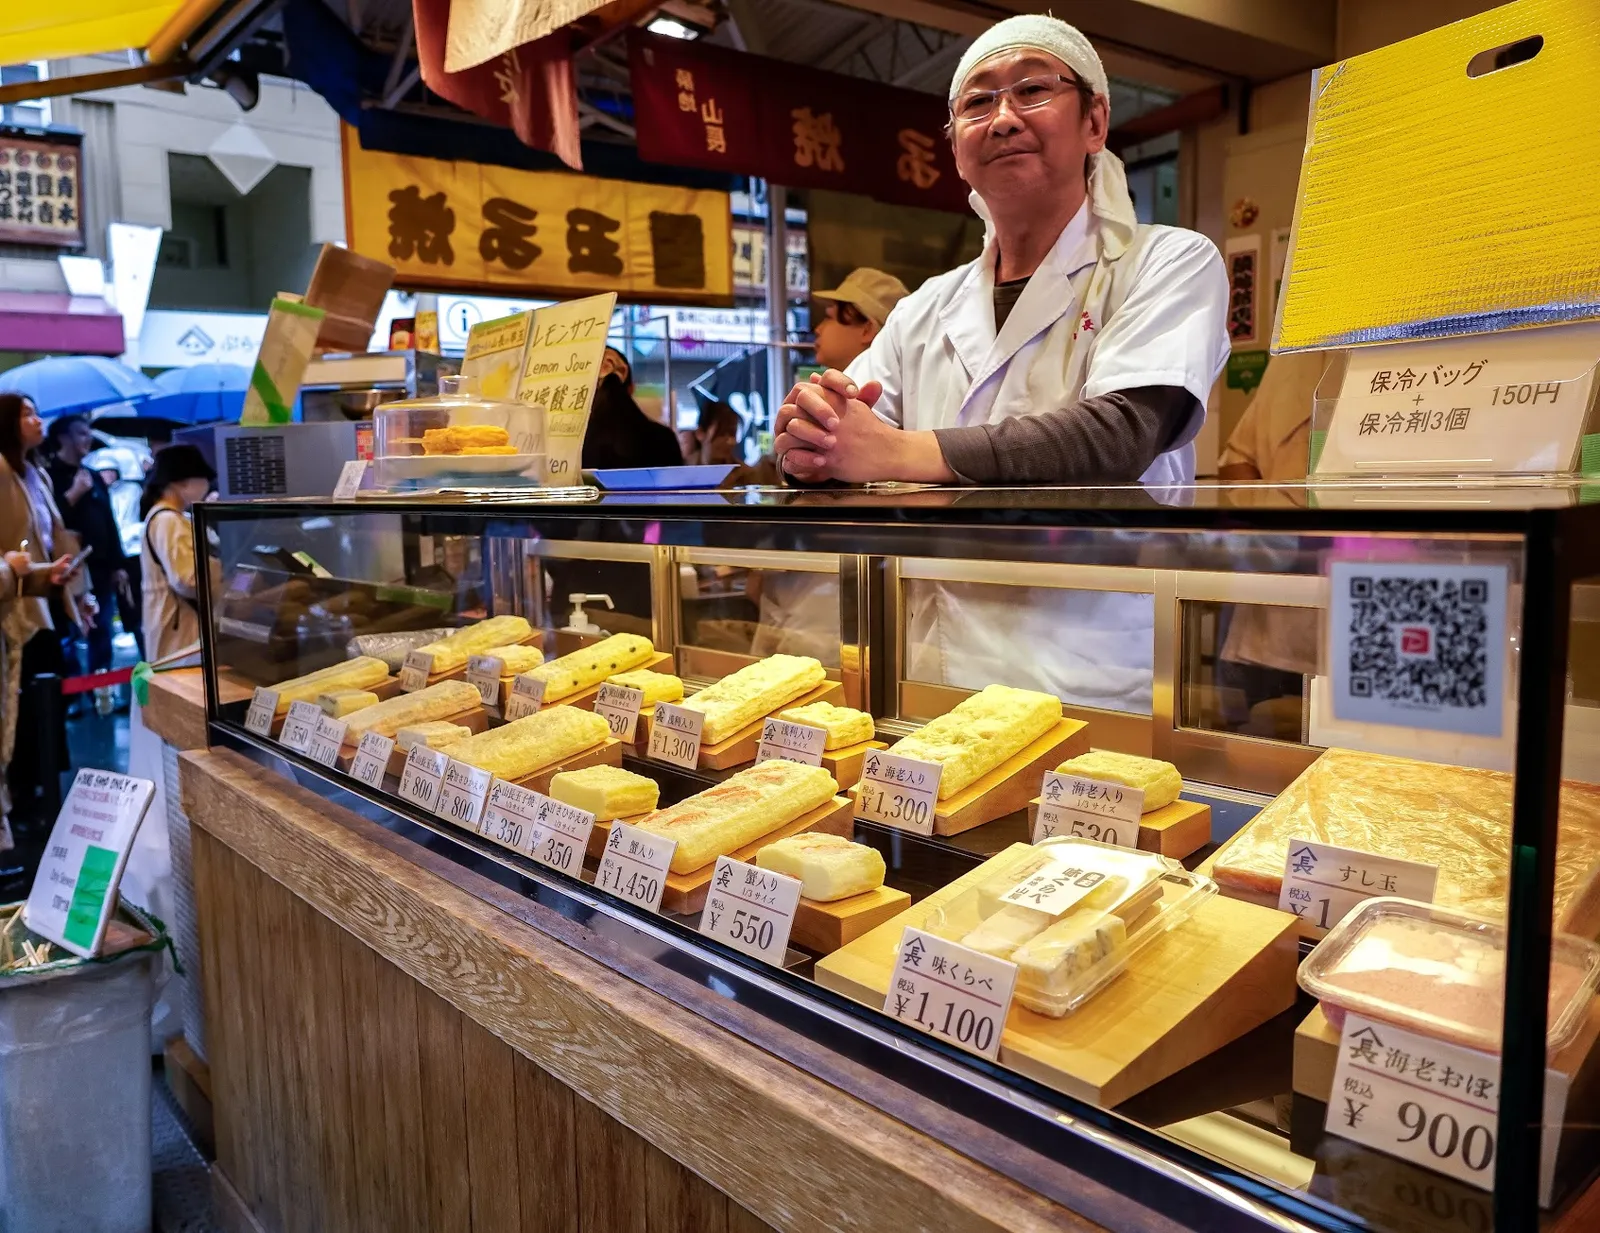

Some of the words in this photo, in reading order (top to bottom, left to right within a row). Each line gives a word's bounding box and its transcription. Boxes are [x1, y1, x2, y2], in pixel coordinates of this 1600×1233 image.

[532, 317, 605, 348] レモンサワー
[524, 358, 559, 378] Lemon
[566, 353, 592, 374] Sour
[1370, 359, 1488, 393] 保冷バッグ
[1491, 383, 1560, 406] 150円
[1358, 407, 1470, 436] 保冷剤3個
[291, 725, 309, 745] 550
[608, 713, 629, 735] 530
[781, 724, 814, 740] 浅利入り
[653, 735, 695, 761] ¥1,300
[361, 760, 379, 783] 450
[884, 765, 925, 785] 海老入り
[412, 775, 433, 802] 800
[862, 785, 874, 795] 税込
[1072, 781, 1123, 803] 海老入り
[451, 795, 474, 823] 800
[861, 791, 927, 824] ¥1,300
[1093, 803, 1116, 814] サイズ
[496, 817, 523, 848] 350
[1071, 820, 1118, 845] 530
[544, 838, 573, 870] 350
[629, 840, 654, 860] 蟹入り
[602, 866, 657, 904] ¥1,450
[745, 868, 778, 892] 蟹入り
[1339, 865, 1398, 893] すし玉
[711, 898, 725, 911] 税込
[754, 892, 775, 905] サイズ
[1289, 887, 1312, 902] 税込
[730, 909, 773, 950] 550
[932, 955, 994, 991] 味くらべ
[897, 977, 915, 995] 税込
[894, 992, 994, 1050] ¥1,100
[1385, 1047, 1499, 1100] 海老おぼ
[1344, 1077, 1374, 1100] 税込
[1344, 1098, 1370, 1128] ¥
[1397, 1102, 1494, 1172] 900
